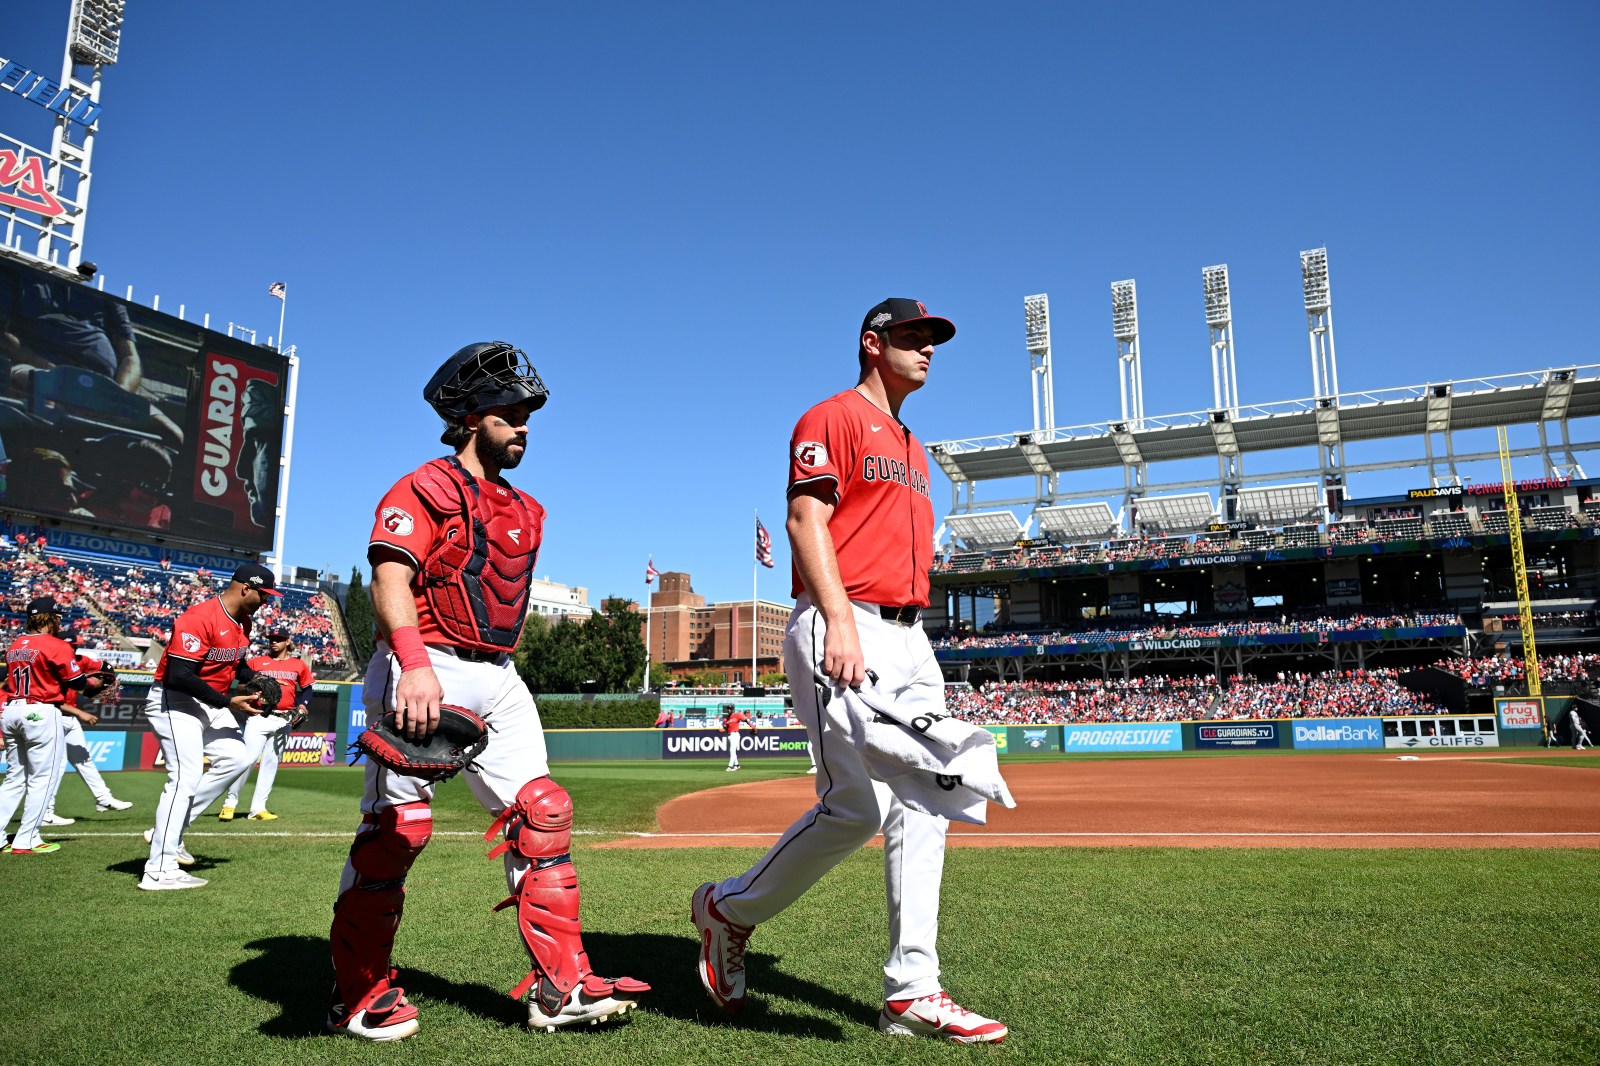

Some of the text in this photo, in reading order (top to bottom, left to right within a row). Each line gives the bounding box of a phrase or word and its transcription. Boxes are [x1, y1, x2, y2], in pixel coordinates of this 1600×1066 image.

[201, 360, 238, 497] GUARDS
[1521, 476, 1572, 491] DISTRICT
[69, 534, 153, 558] HONDA
[12, 664, 31, 697] 11
[1503, 702, 1533, 716] drug
[1507, 716, 1541, 725] mart
[667, 736, 728, 752] UNION
[1068, 729, 1174, 746] PROGRESSIVE
[1429, 737, 1484, 746] CLIFFS
[282, 751, 321, 763] WORKS
